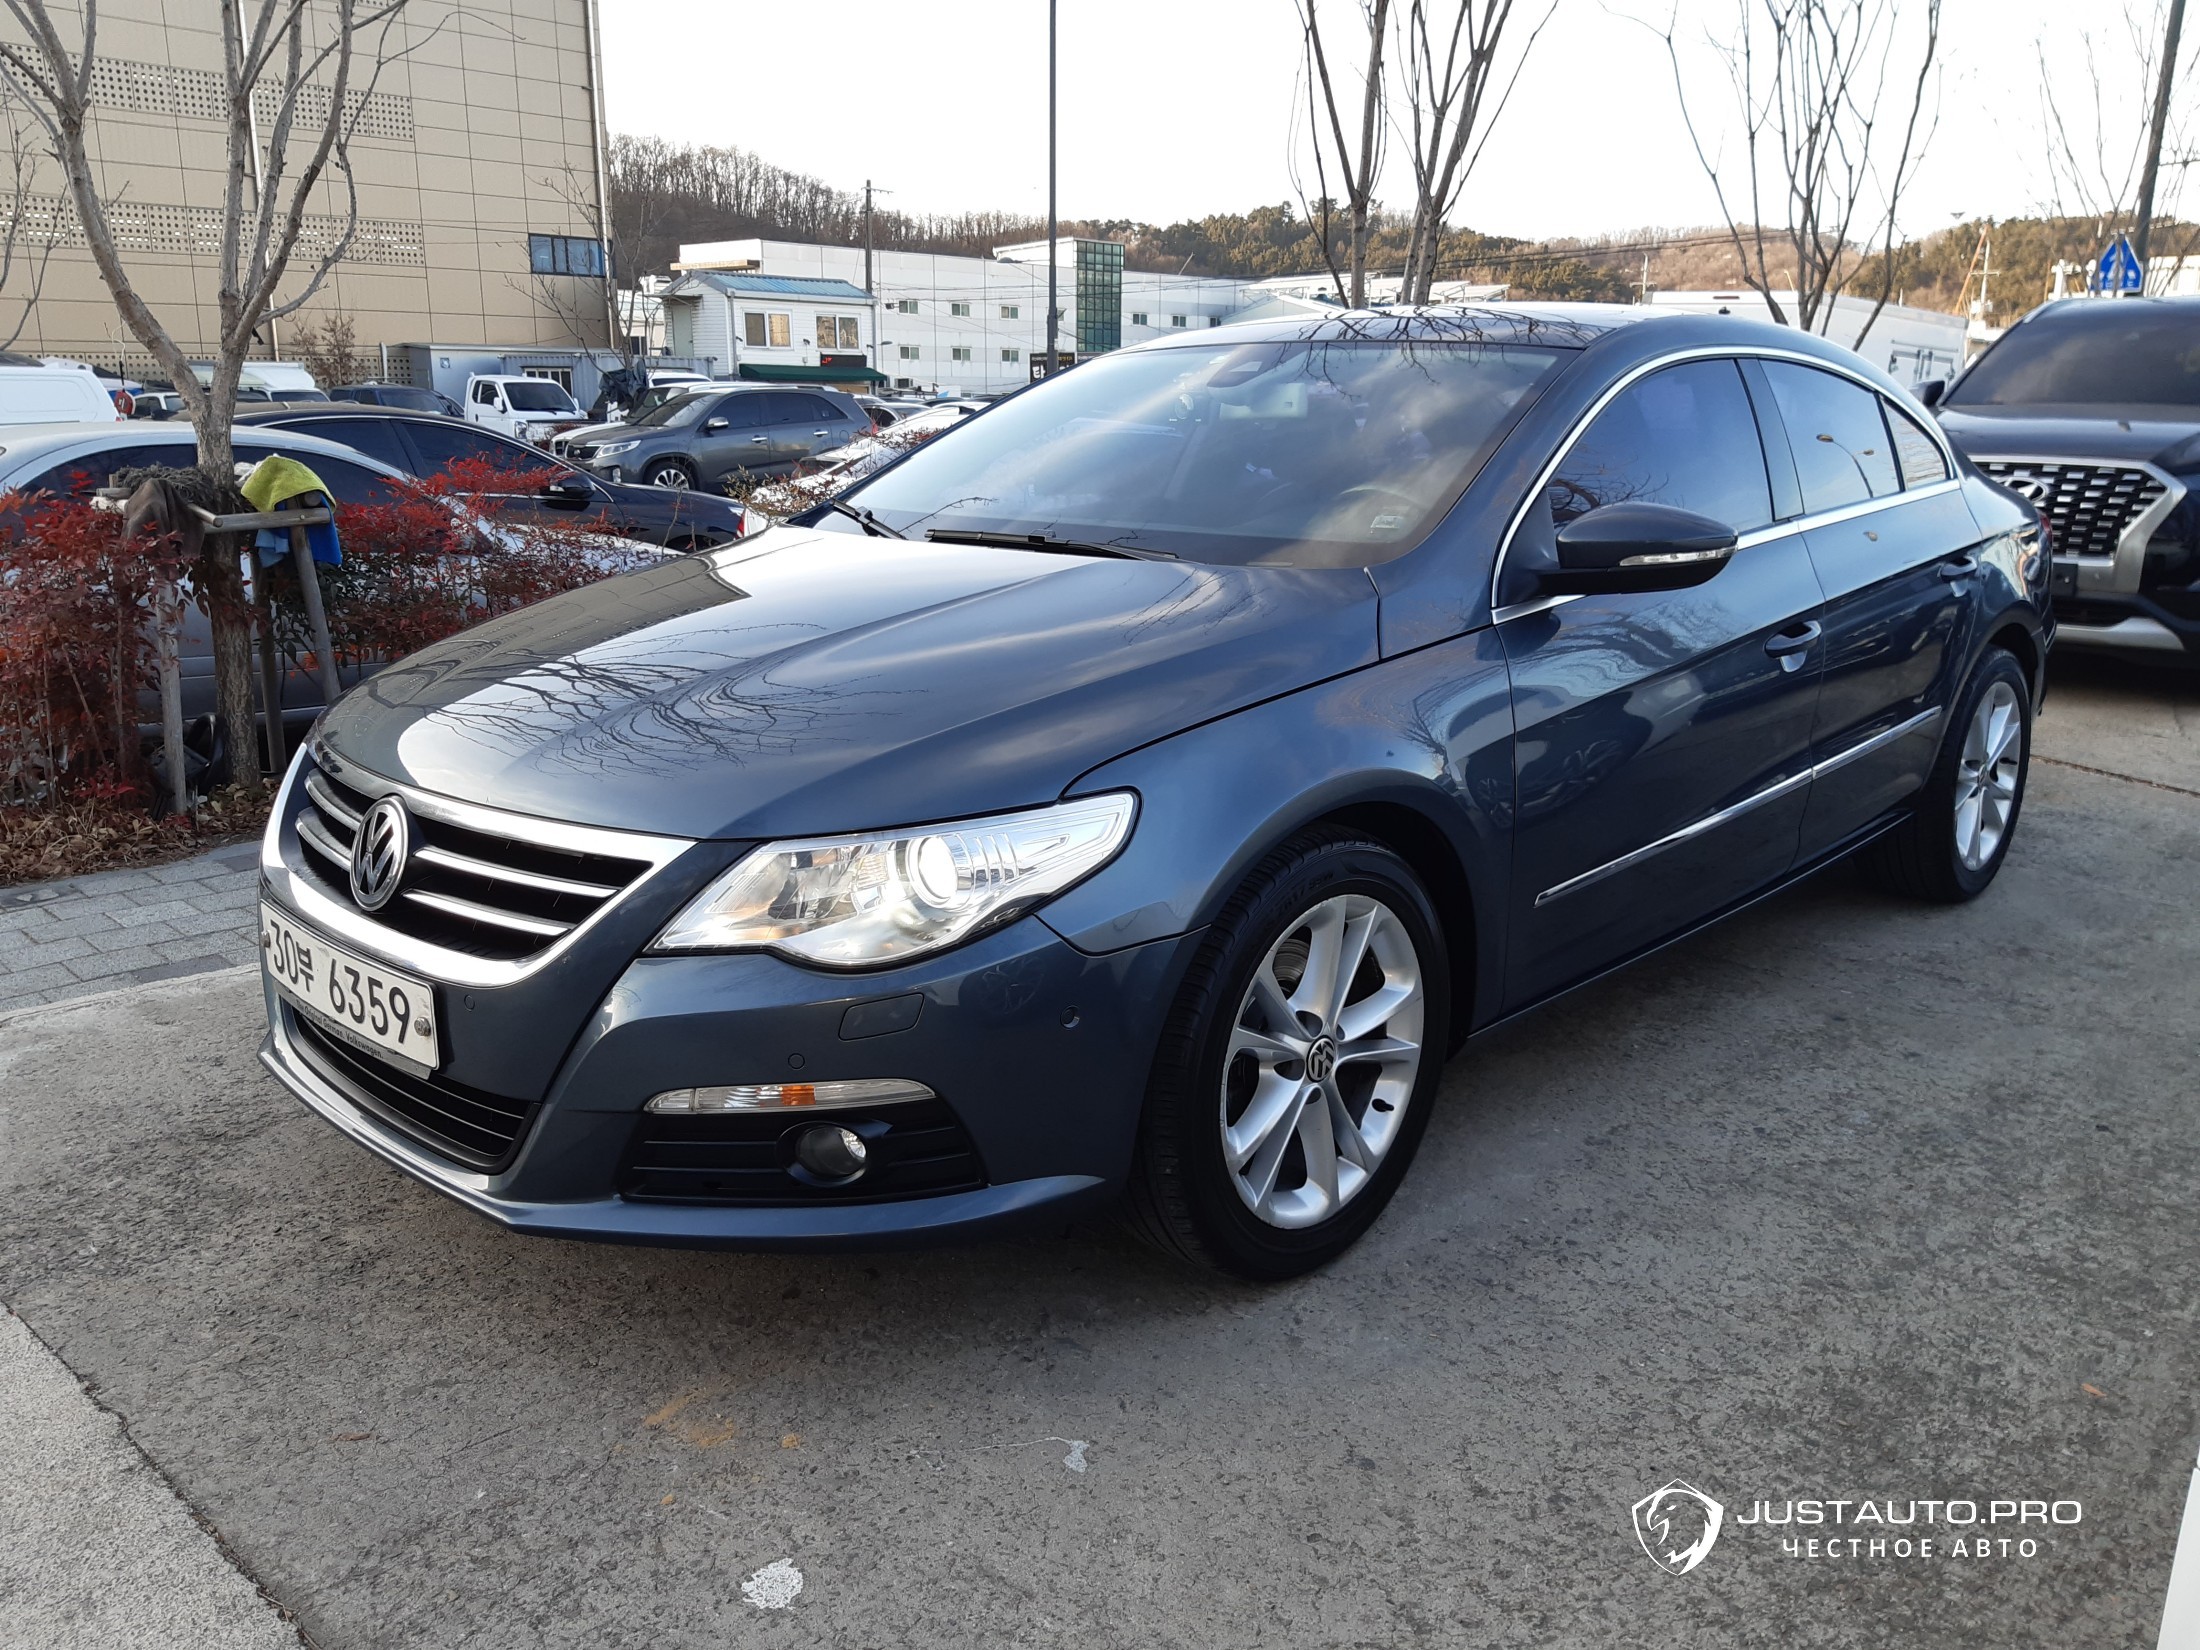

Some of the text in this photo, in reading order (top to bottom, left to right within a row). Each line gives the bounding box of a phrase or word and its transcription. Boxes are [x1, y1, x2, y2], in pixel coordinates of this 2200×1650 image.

[270, 918, 411, 1045] 30부 6359
[346, 1031, 384, 1059] Volkswagen.
